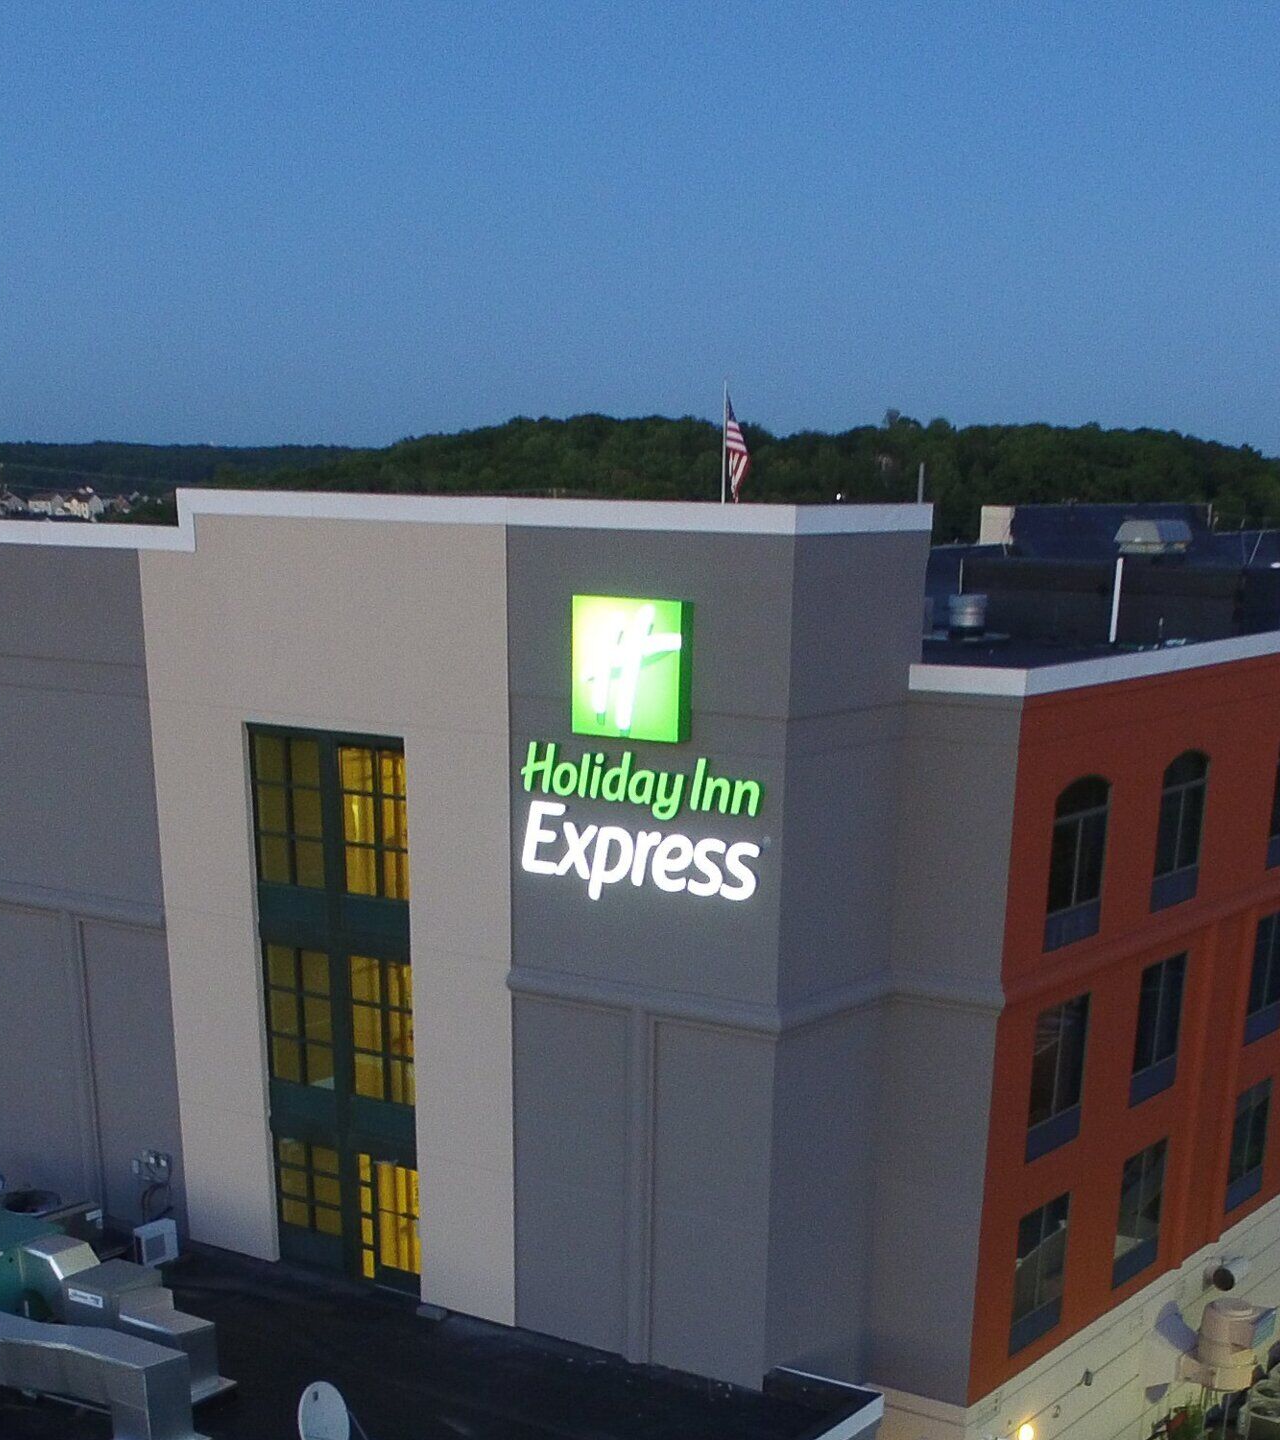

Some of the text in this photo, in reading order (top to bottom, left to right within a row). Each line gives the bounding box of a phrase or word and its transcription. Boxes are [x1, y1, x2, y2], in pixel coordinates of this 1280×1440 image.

[521, 741, 761, 821] Holiday Inn
[521, 800, 761, 901] Express
